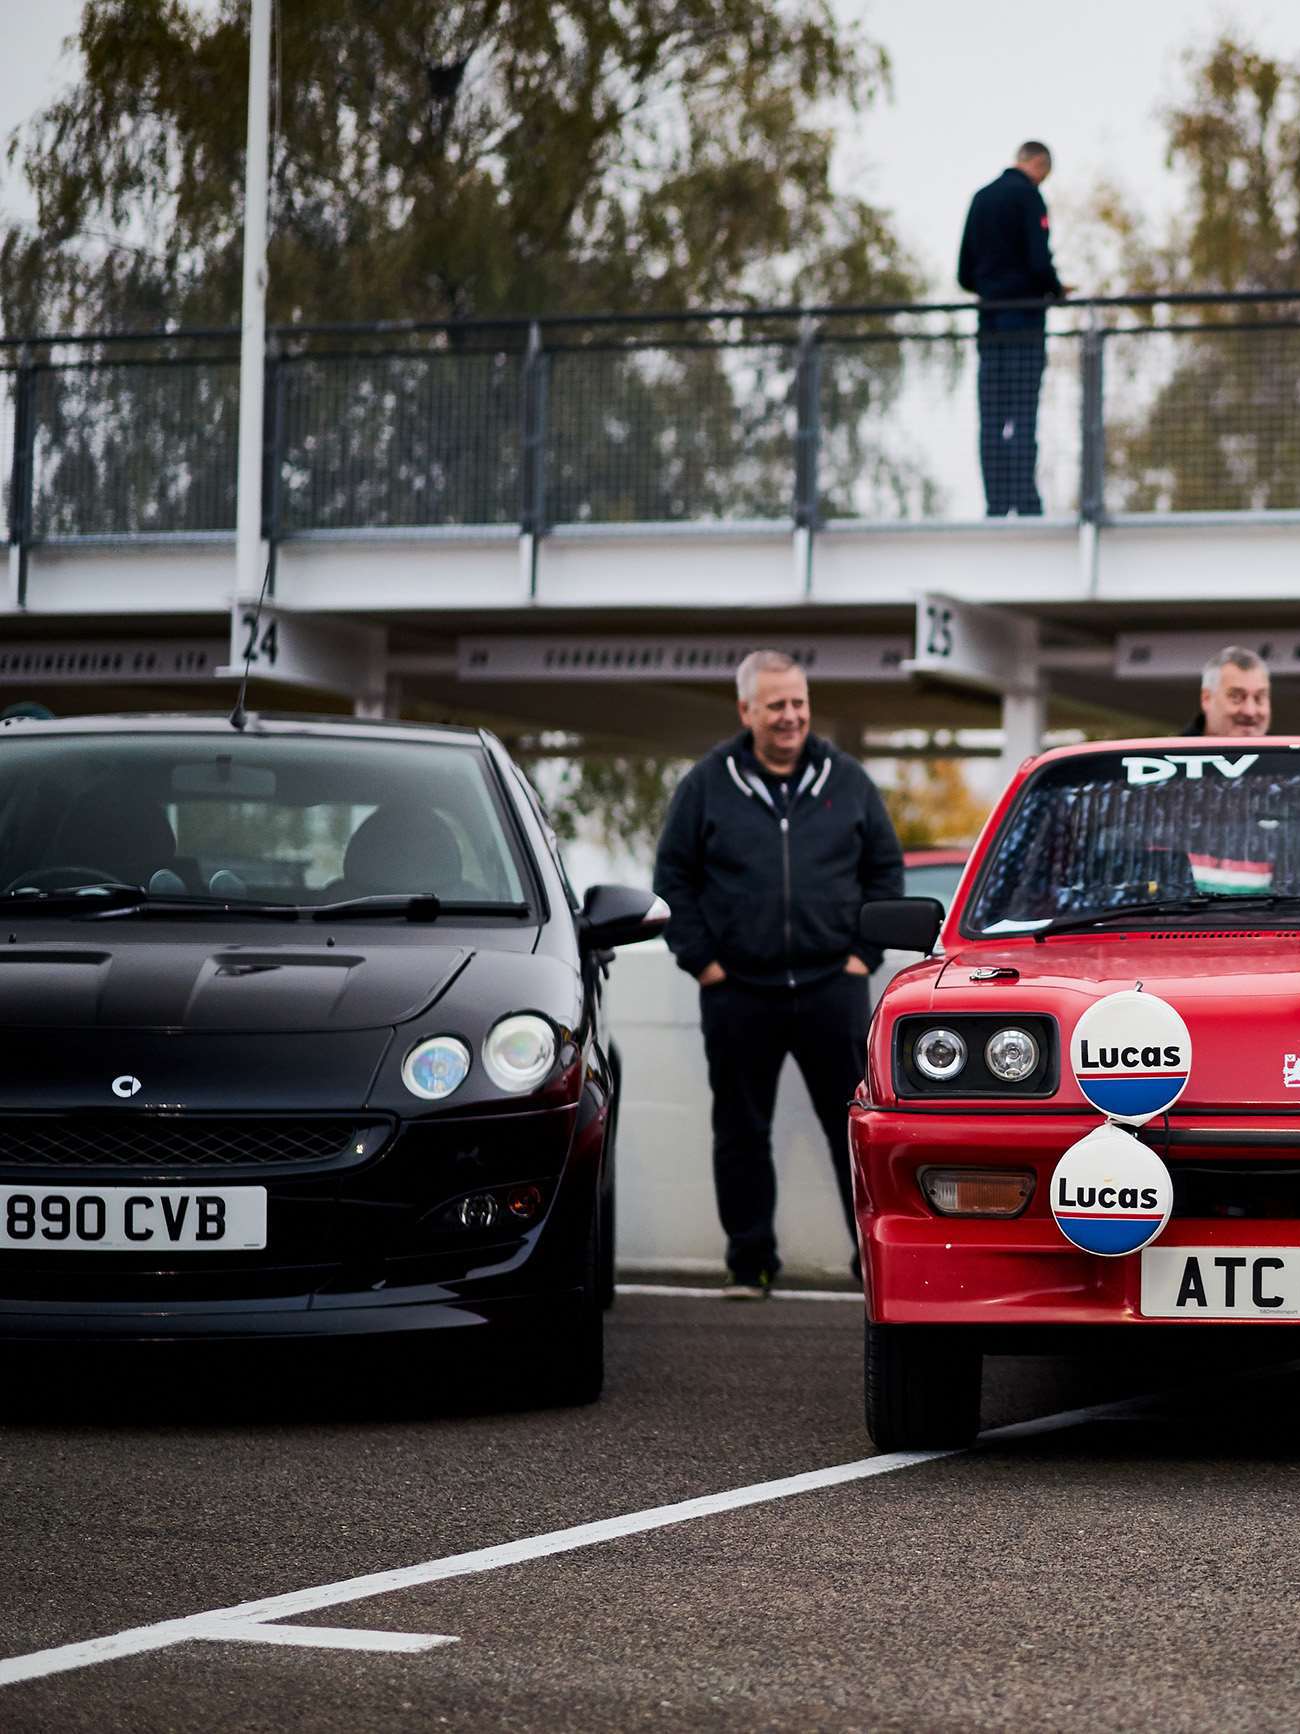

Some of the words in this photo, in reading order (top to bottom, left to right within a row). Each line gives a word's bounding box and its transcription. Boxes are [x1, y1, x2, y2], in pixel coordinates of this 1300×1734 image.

[243, 612, 278, 666] 24
[1122, 754, 1259, 784] DTV
[1081, 1040, 1181, 1068] Lucas
[1058, 1178, 1158, 1209] Lucas
[6, 1194, 106, 1241] 890
[124, 1196, 226, 1241] CVB
[1176, 1256, 1285, 1308] ATC
